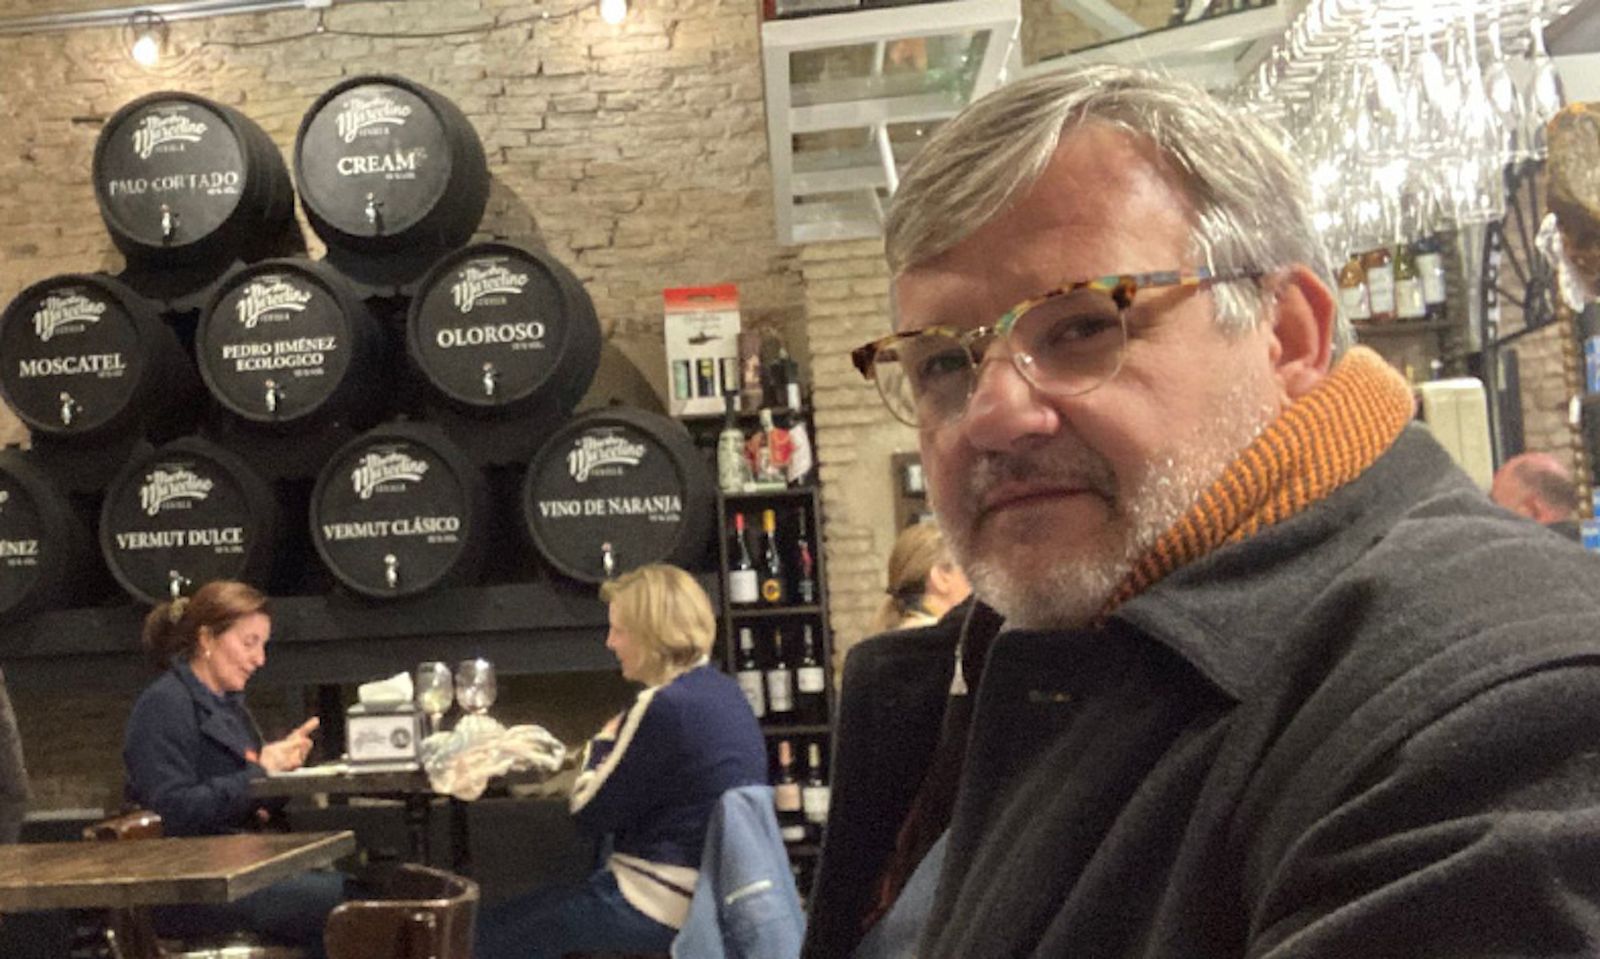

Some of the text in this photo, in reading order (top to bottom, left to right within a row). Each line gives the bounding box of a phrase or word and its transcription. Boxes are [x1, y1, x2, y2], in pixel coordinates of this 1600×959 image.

[337, 151, 415, 176] CREAM
[152, 170, 239, 192] CORTADO
[436, 321, 545, 349] OLOROSO
[222, 342, 272, 359] PEDRO
[19, 352, 126, 378] MOSCATEL
[540, 495, 682, 517] VINO DE NARANJA
[116, 527, 243, 550] VERMUT DULCE
[323, 516, 459, 540] VERMUT CLÁSICO
